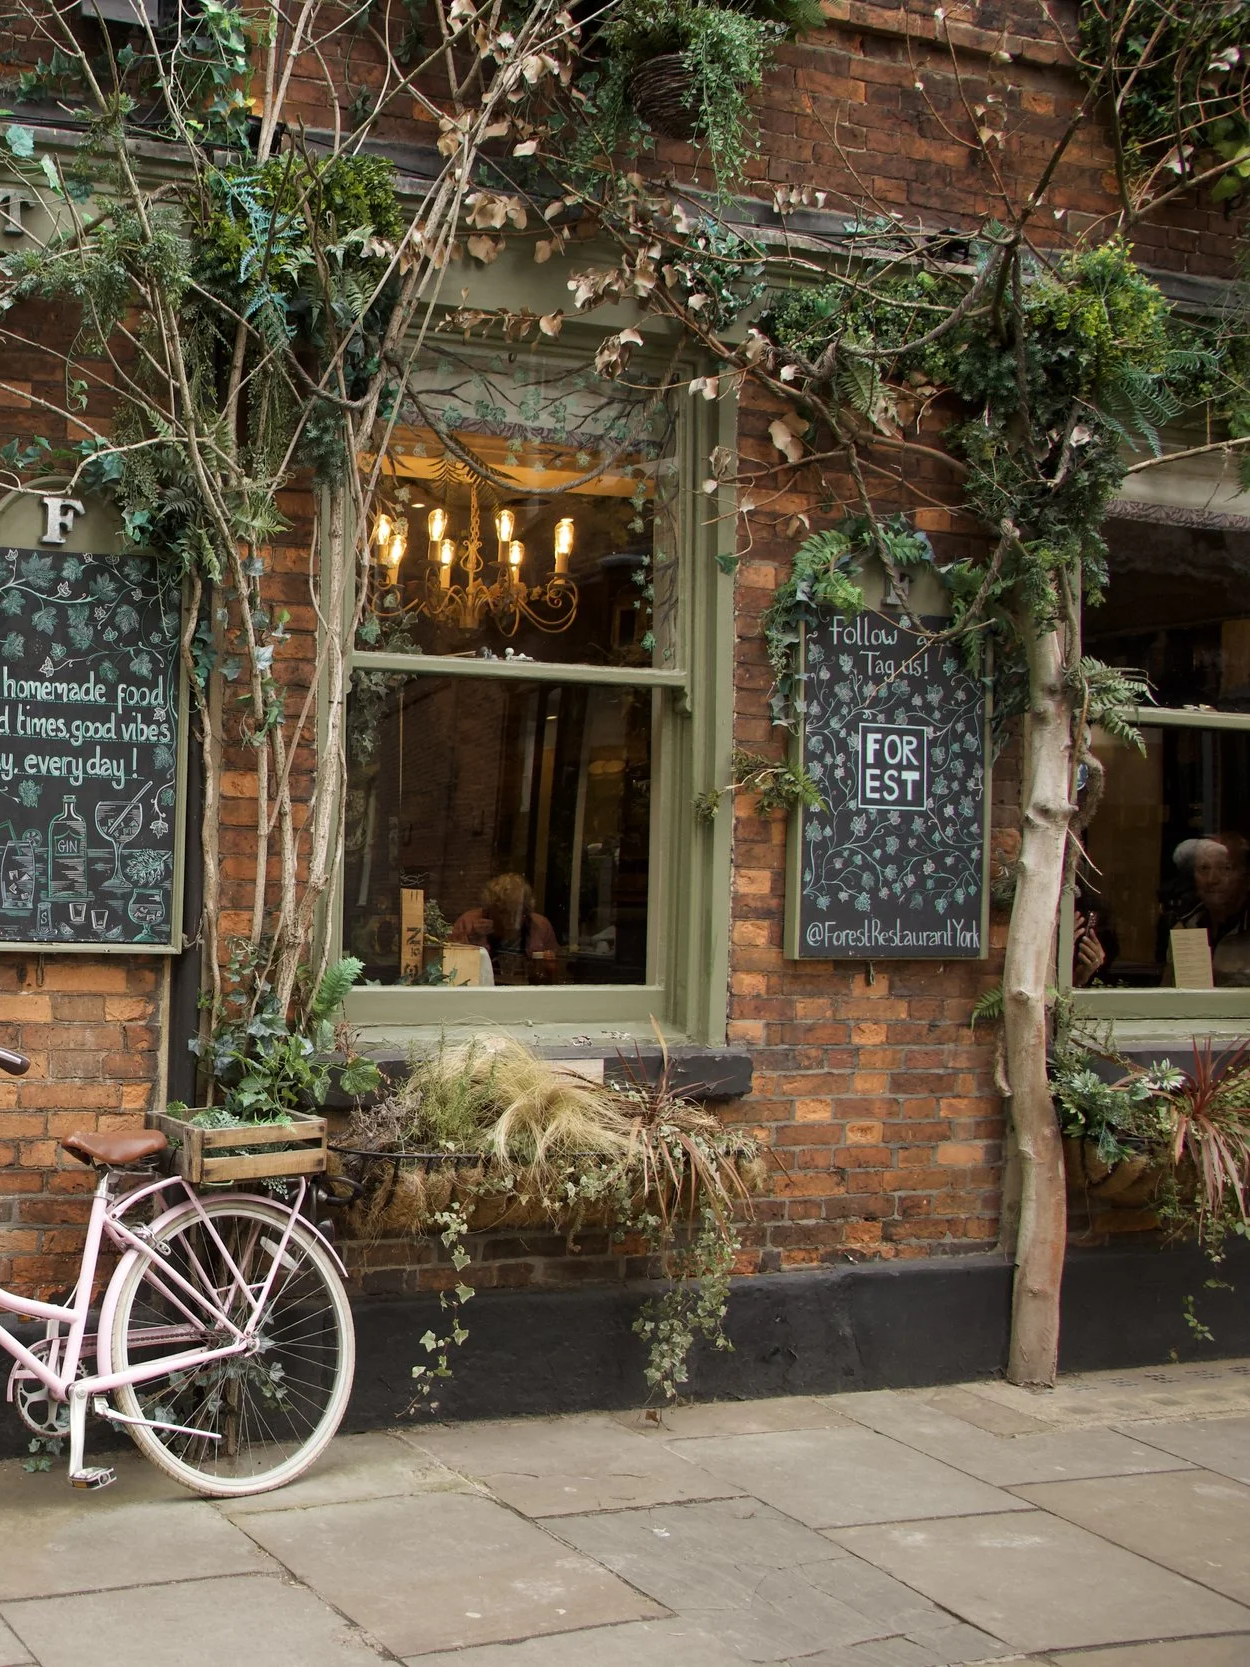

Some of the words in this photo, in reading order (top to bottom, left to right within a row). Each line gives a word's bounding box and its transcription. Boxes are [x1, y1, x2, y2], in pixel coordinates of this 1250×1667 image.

[42, 496, 86, 543] F
[828, 615, 898, 646] Follow
[859, 650, 895, 682] Tag
[3, 666, 106, 703] homemade
[117, 675, 164, 714] food
[121, 712, 171, 743] vibes
[866, 733, 919, 766] FOR
[24, 753, 83, 786] every
[865, 768, 920, 801] EST
[57, 839, 78, 853] GIN
[806, 918, 980, 948] @ForestRestaurantYork
